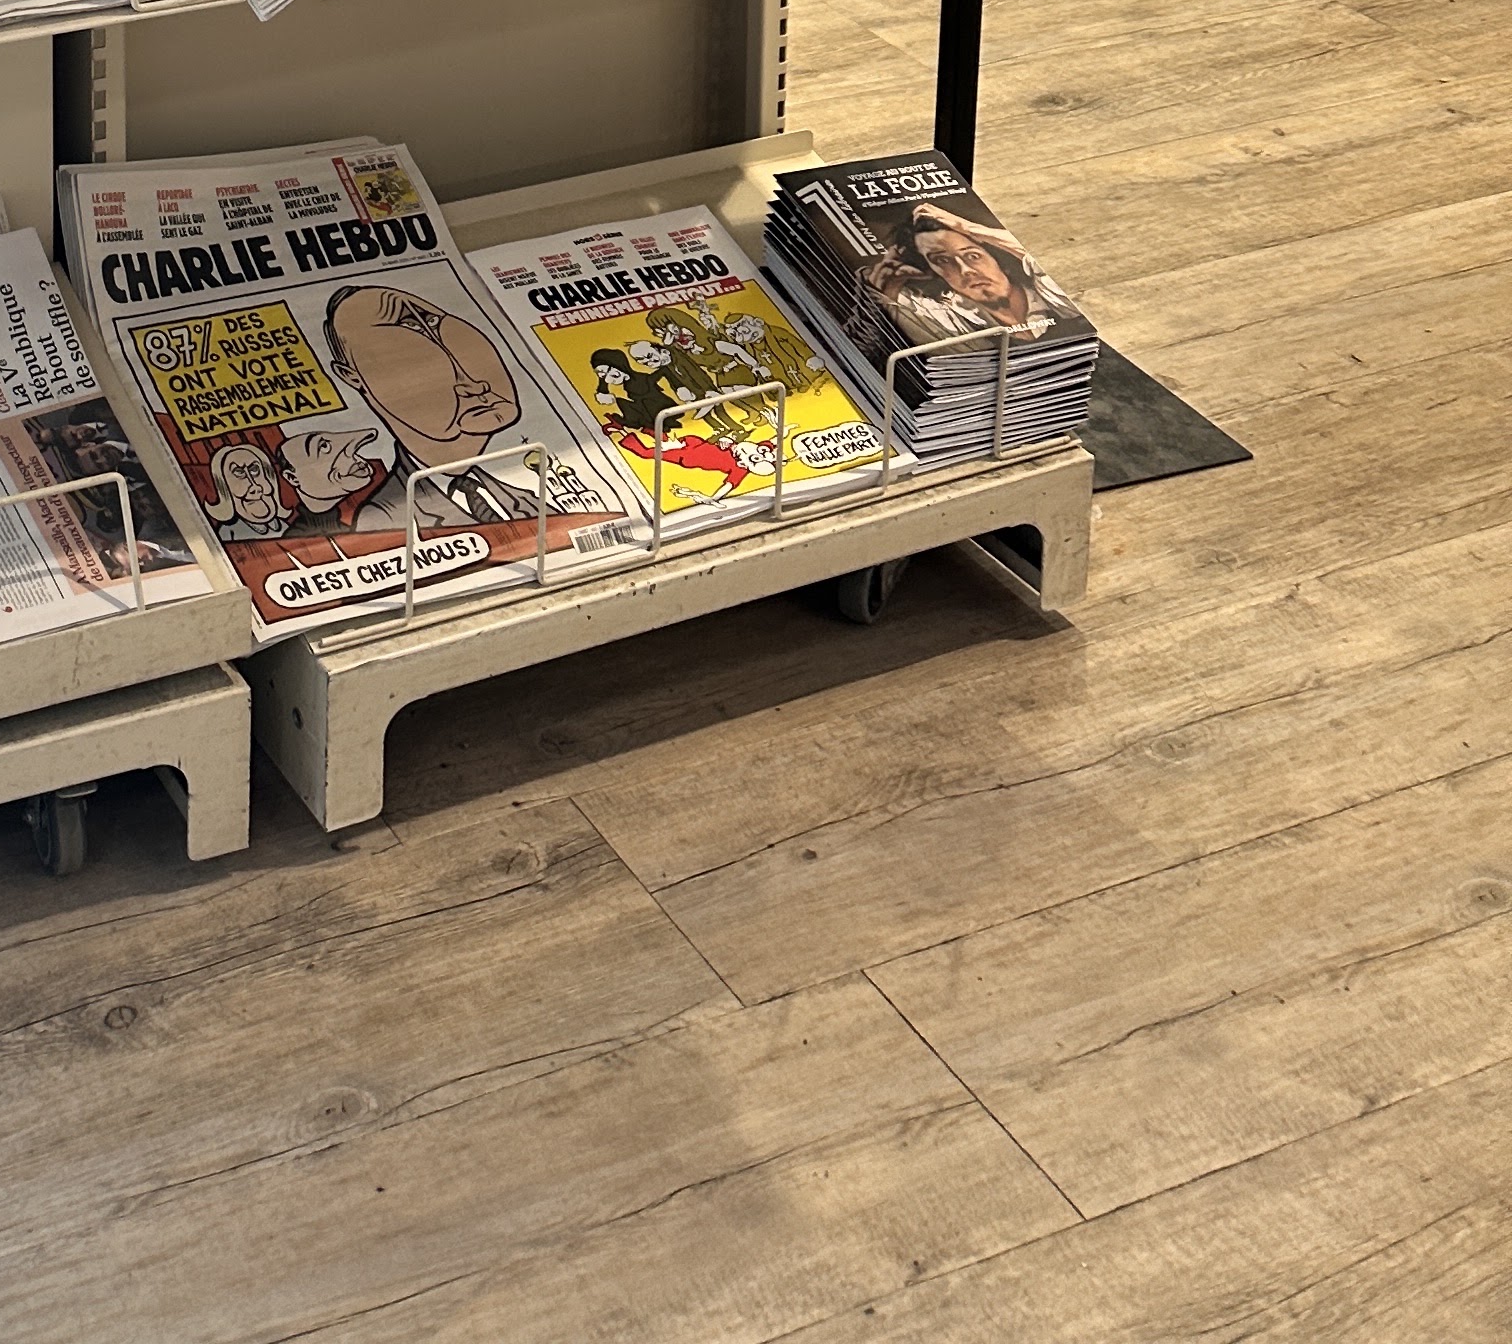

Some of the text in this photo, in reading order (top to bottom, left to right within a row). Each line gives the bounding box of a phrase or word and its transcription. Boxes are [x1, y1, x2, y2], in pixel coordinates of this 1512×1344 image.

[851, 169, 958, 200] LA FOLIE
[101, 213, 439, 303] CHARLIE HEBDO
[527, 253, 728, 314] CHARLIE HEBDO
[545, 296, 645, 329] FÉMINISME
[141, 313, 266, 372] 87% DES
[222, 327, 300, 360] RUSSES
[168, 348, 305, 391] ONT VOTÉ
[178, 368, 319, 416] RASSEMBLEMENT
[800, 426, 870, 452] FEMMES
[279, 578, 312, 603] ON
[316, 569, 354, 594] EST
[356, 556, 406, 587] CHEZ
